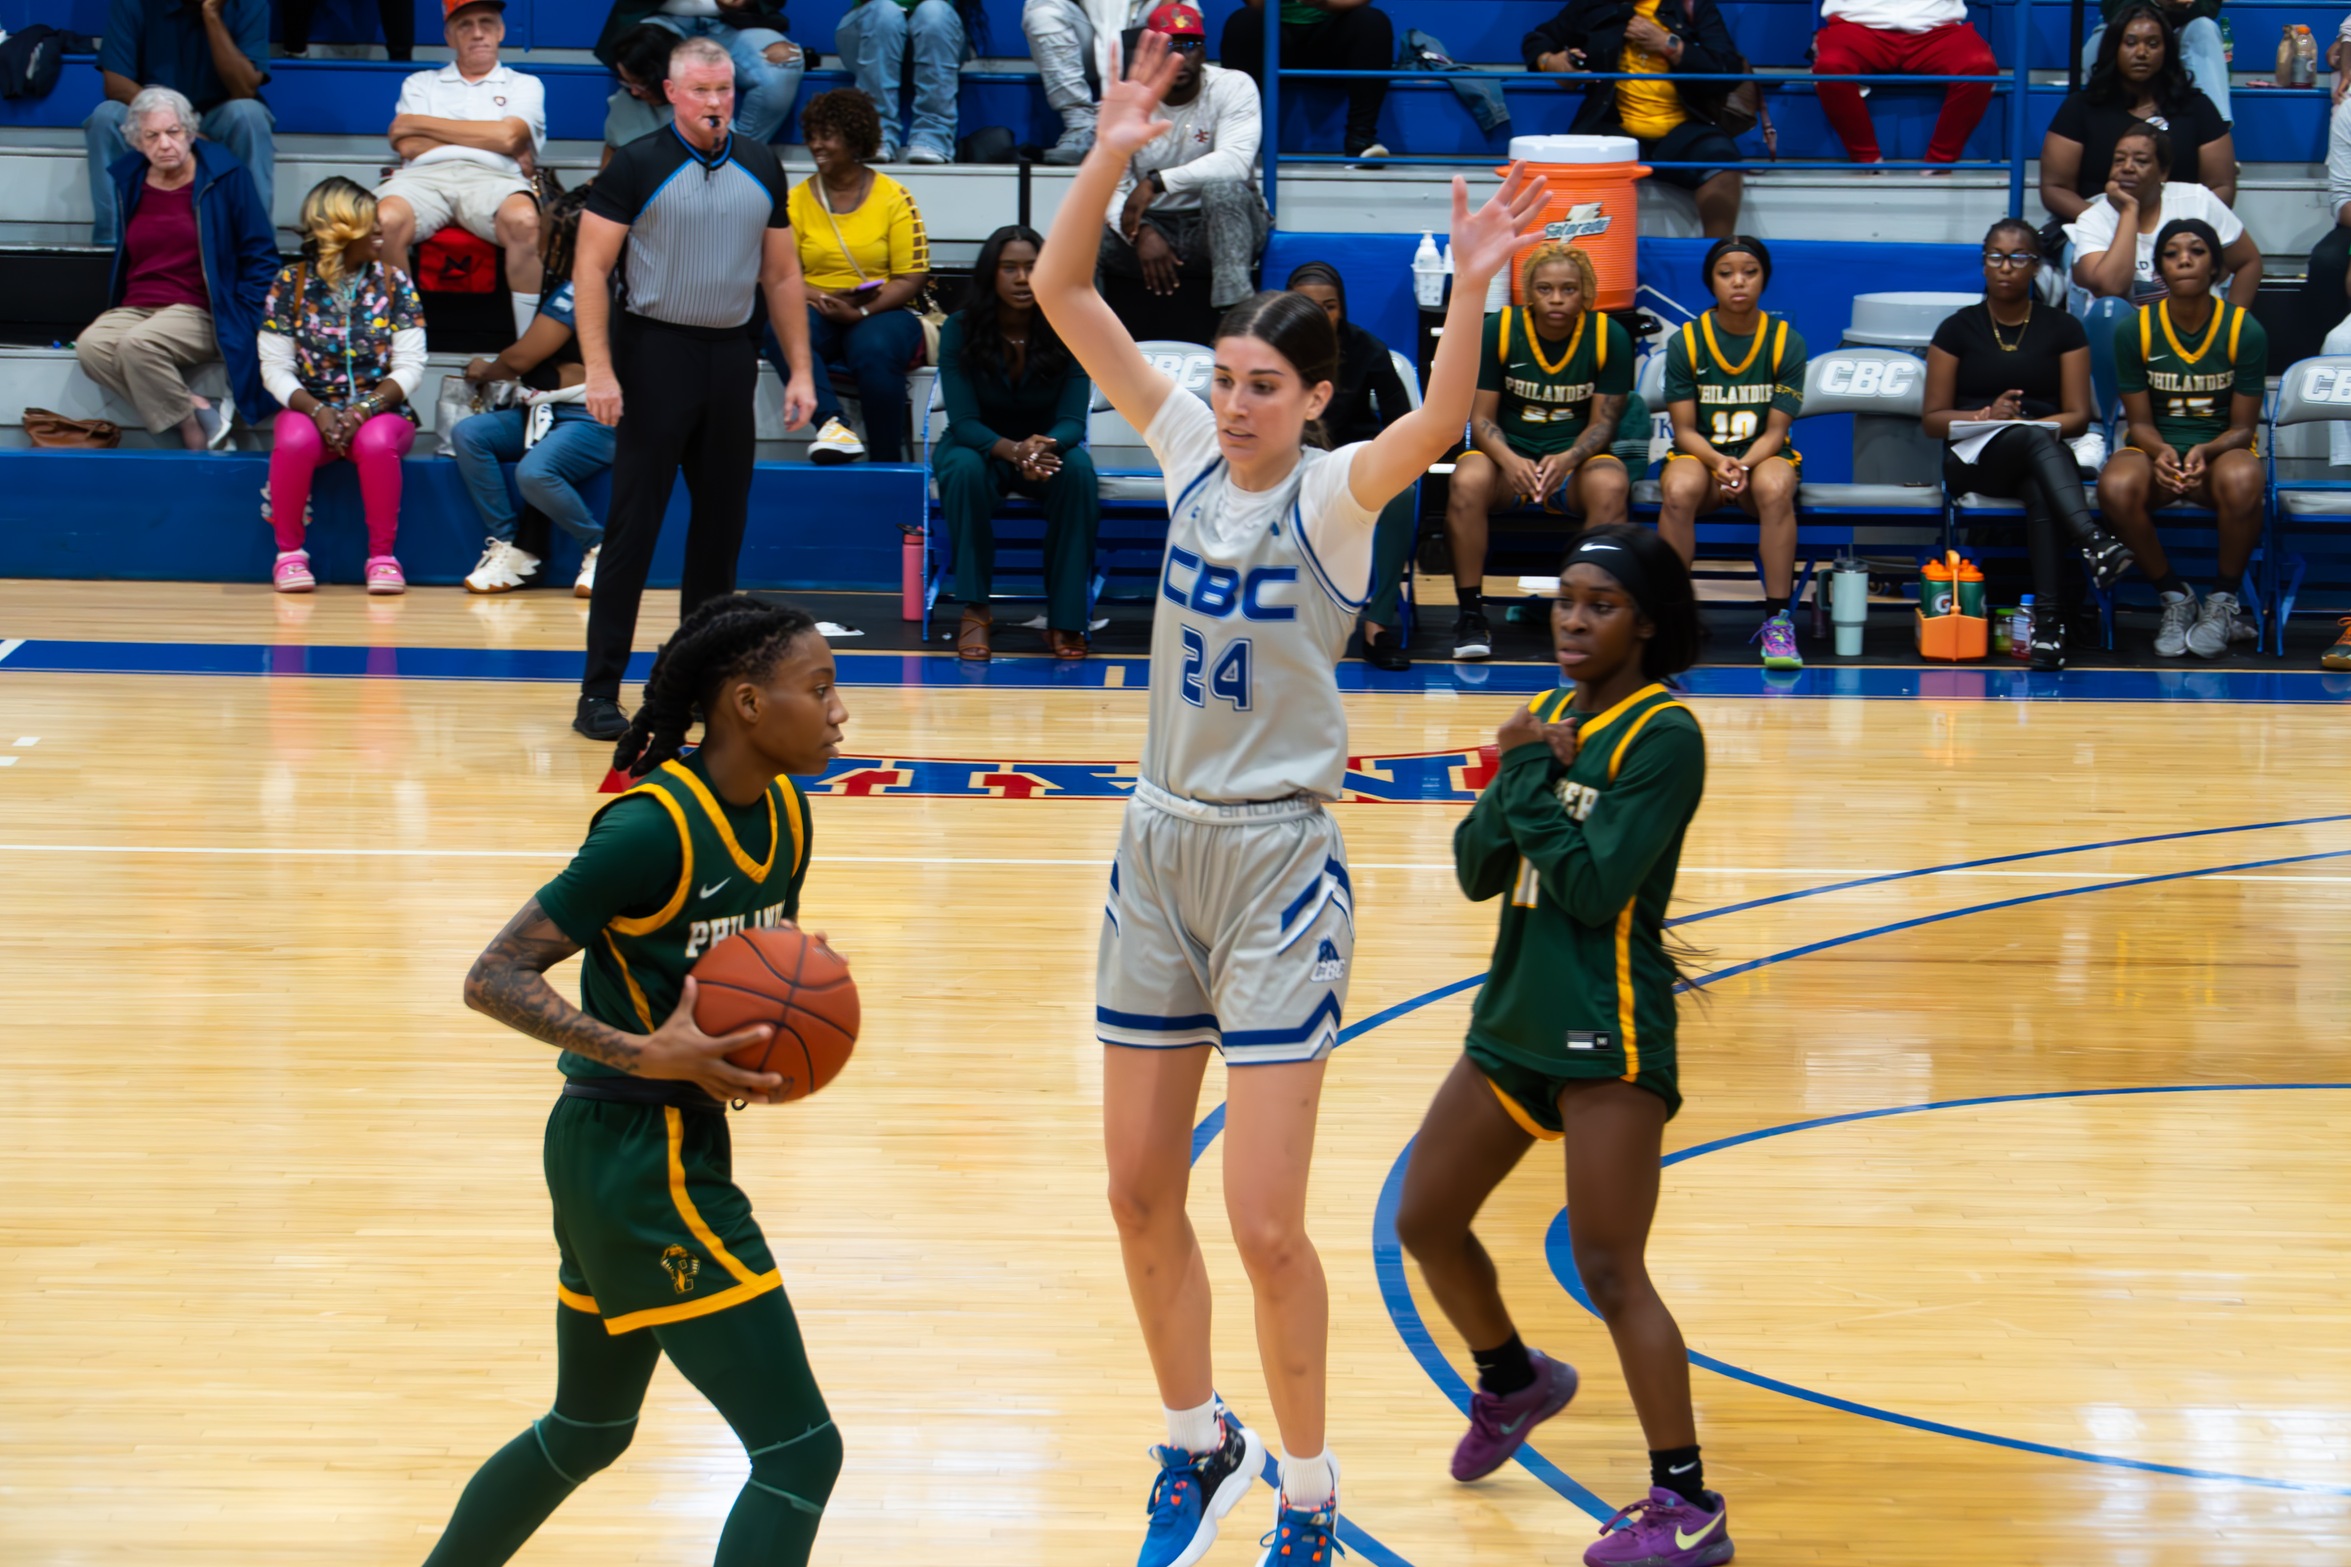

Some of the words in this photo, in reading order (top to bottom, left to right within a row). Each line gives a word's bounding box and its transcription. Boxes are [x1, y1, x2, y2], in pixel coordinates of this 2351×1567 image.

[1140, 352, 1214, 391] BC
[1817, 358, 1917, 397] CBC
[1162, 543, 1299, 622] CBC
[1179, 623, 1252, 711] 24
